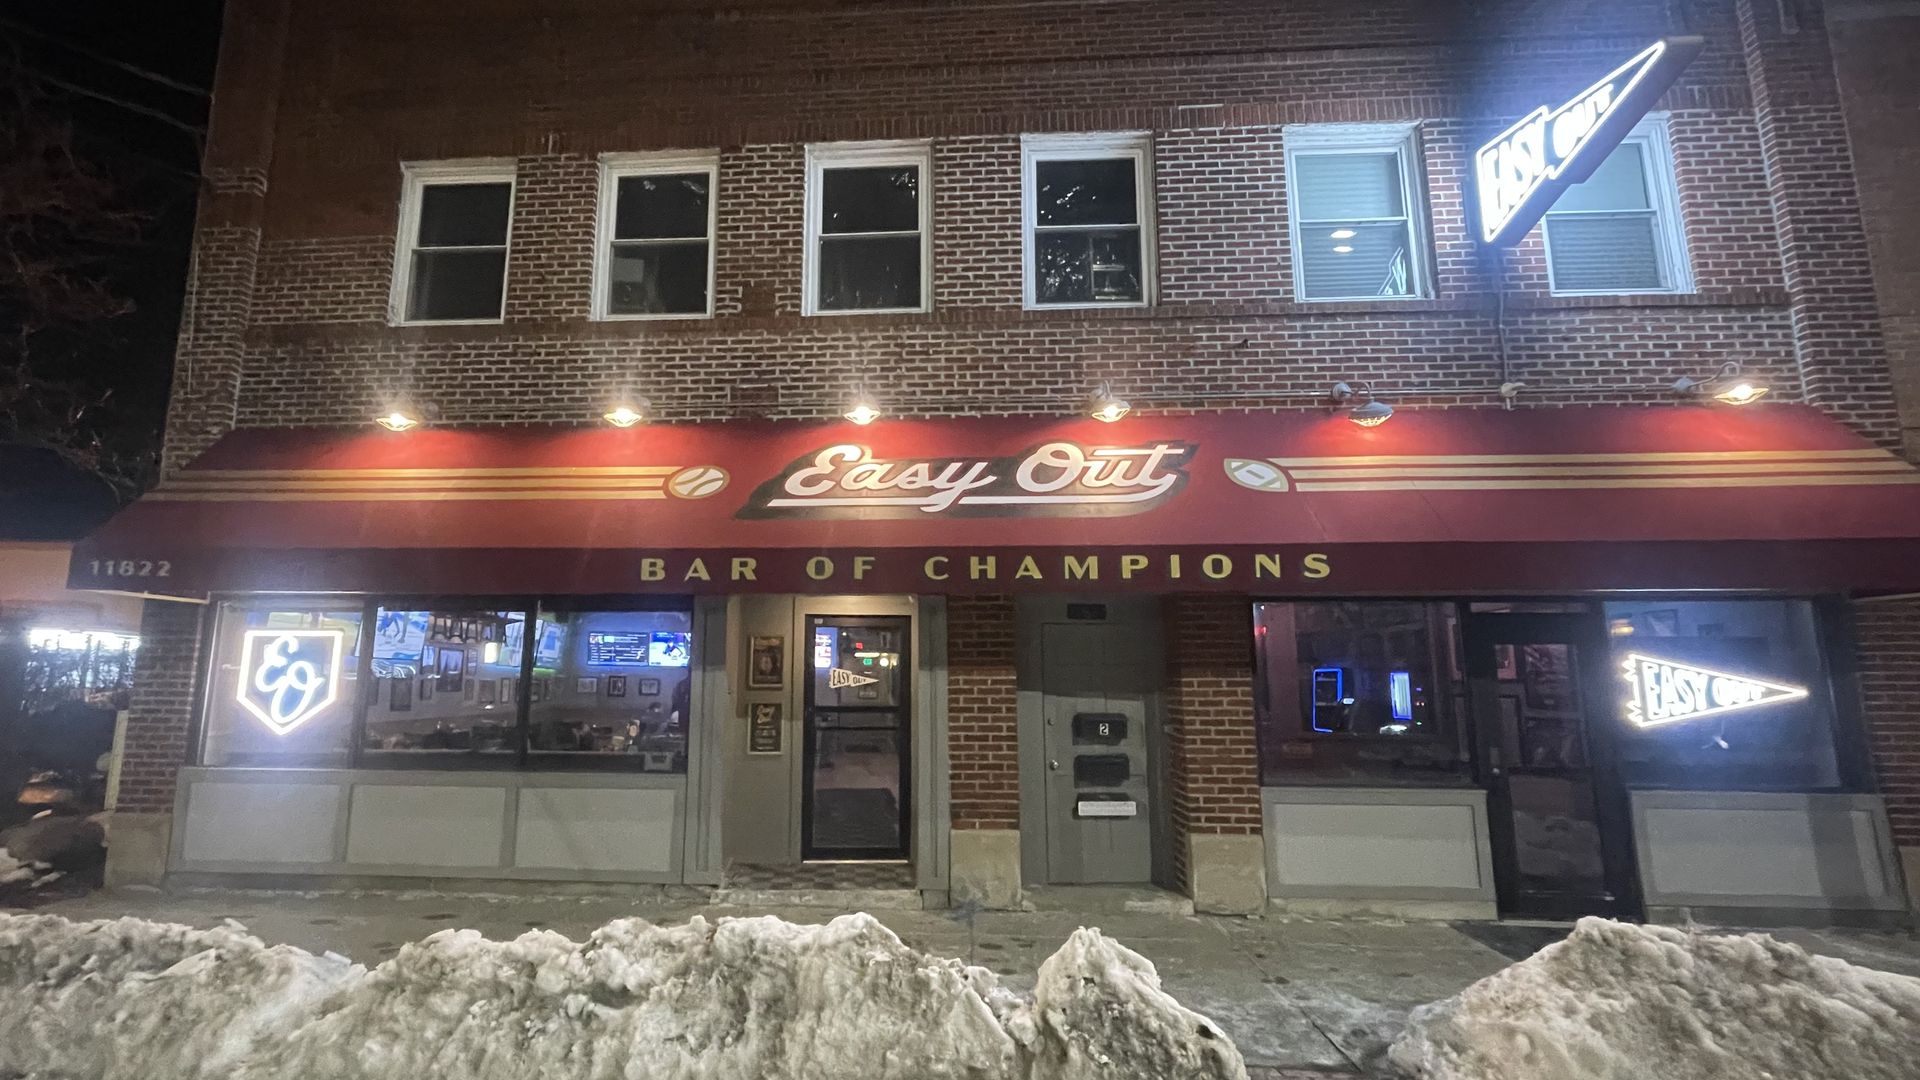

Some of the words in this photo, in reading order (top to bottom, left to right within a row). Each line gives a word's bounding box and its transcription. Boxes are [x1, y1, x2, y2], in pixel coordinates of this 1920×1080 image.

[1481, 115, 1548, 229] EASY
[774, 444, 997, 512] Easy
[1014, 442, 1184, 504] Out
[89, 560, 172, 576] 11822
[640, 557, 757, 581] BAR
[806, 556, 876, 580] OF
[924, 554, 1330, 580] CHAMPIONS
[832, 669, 850, 686] EASY
[1641, 661, 1709, 720] EASY
[1101, 724, 1108, 735] 2
